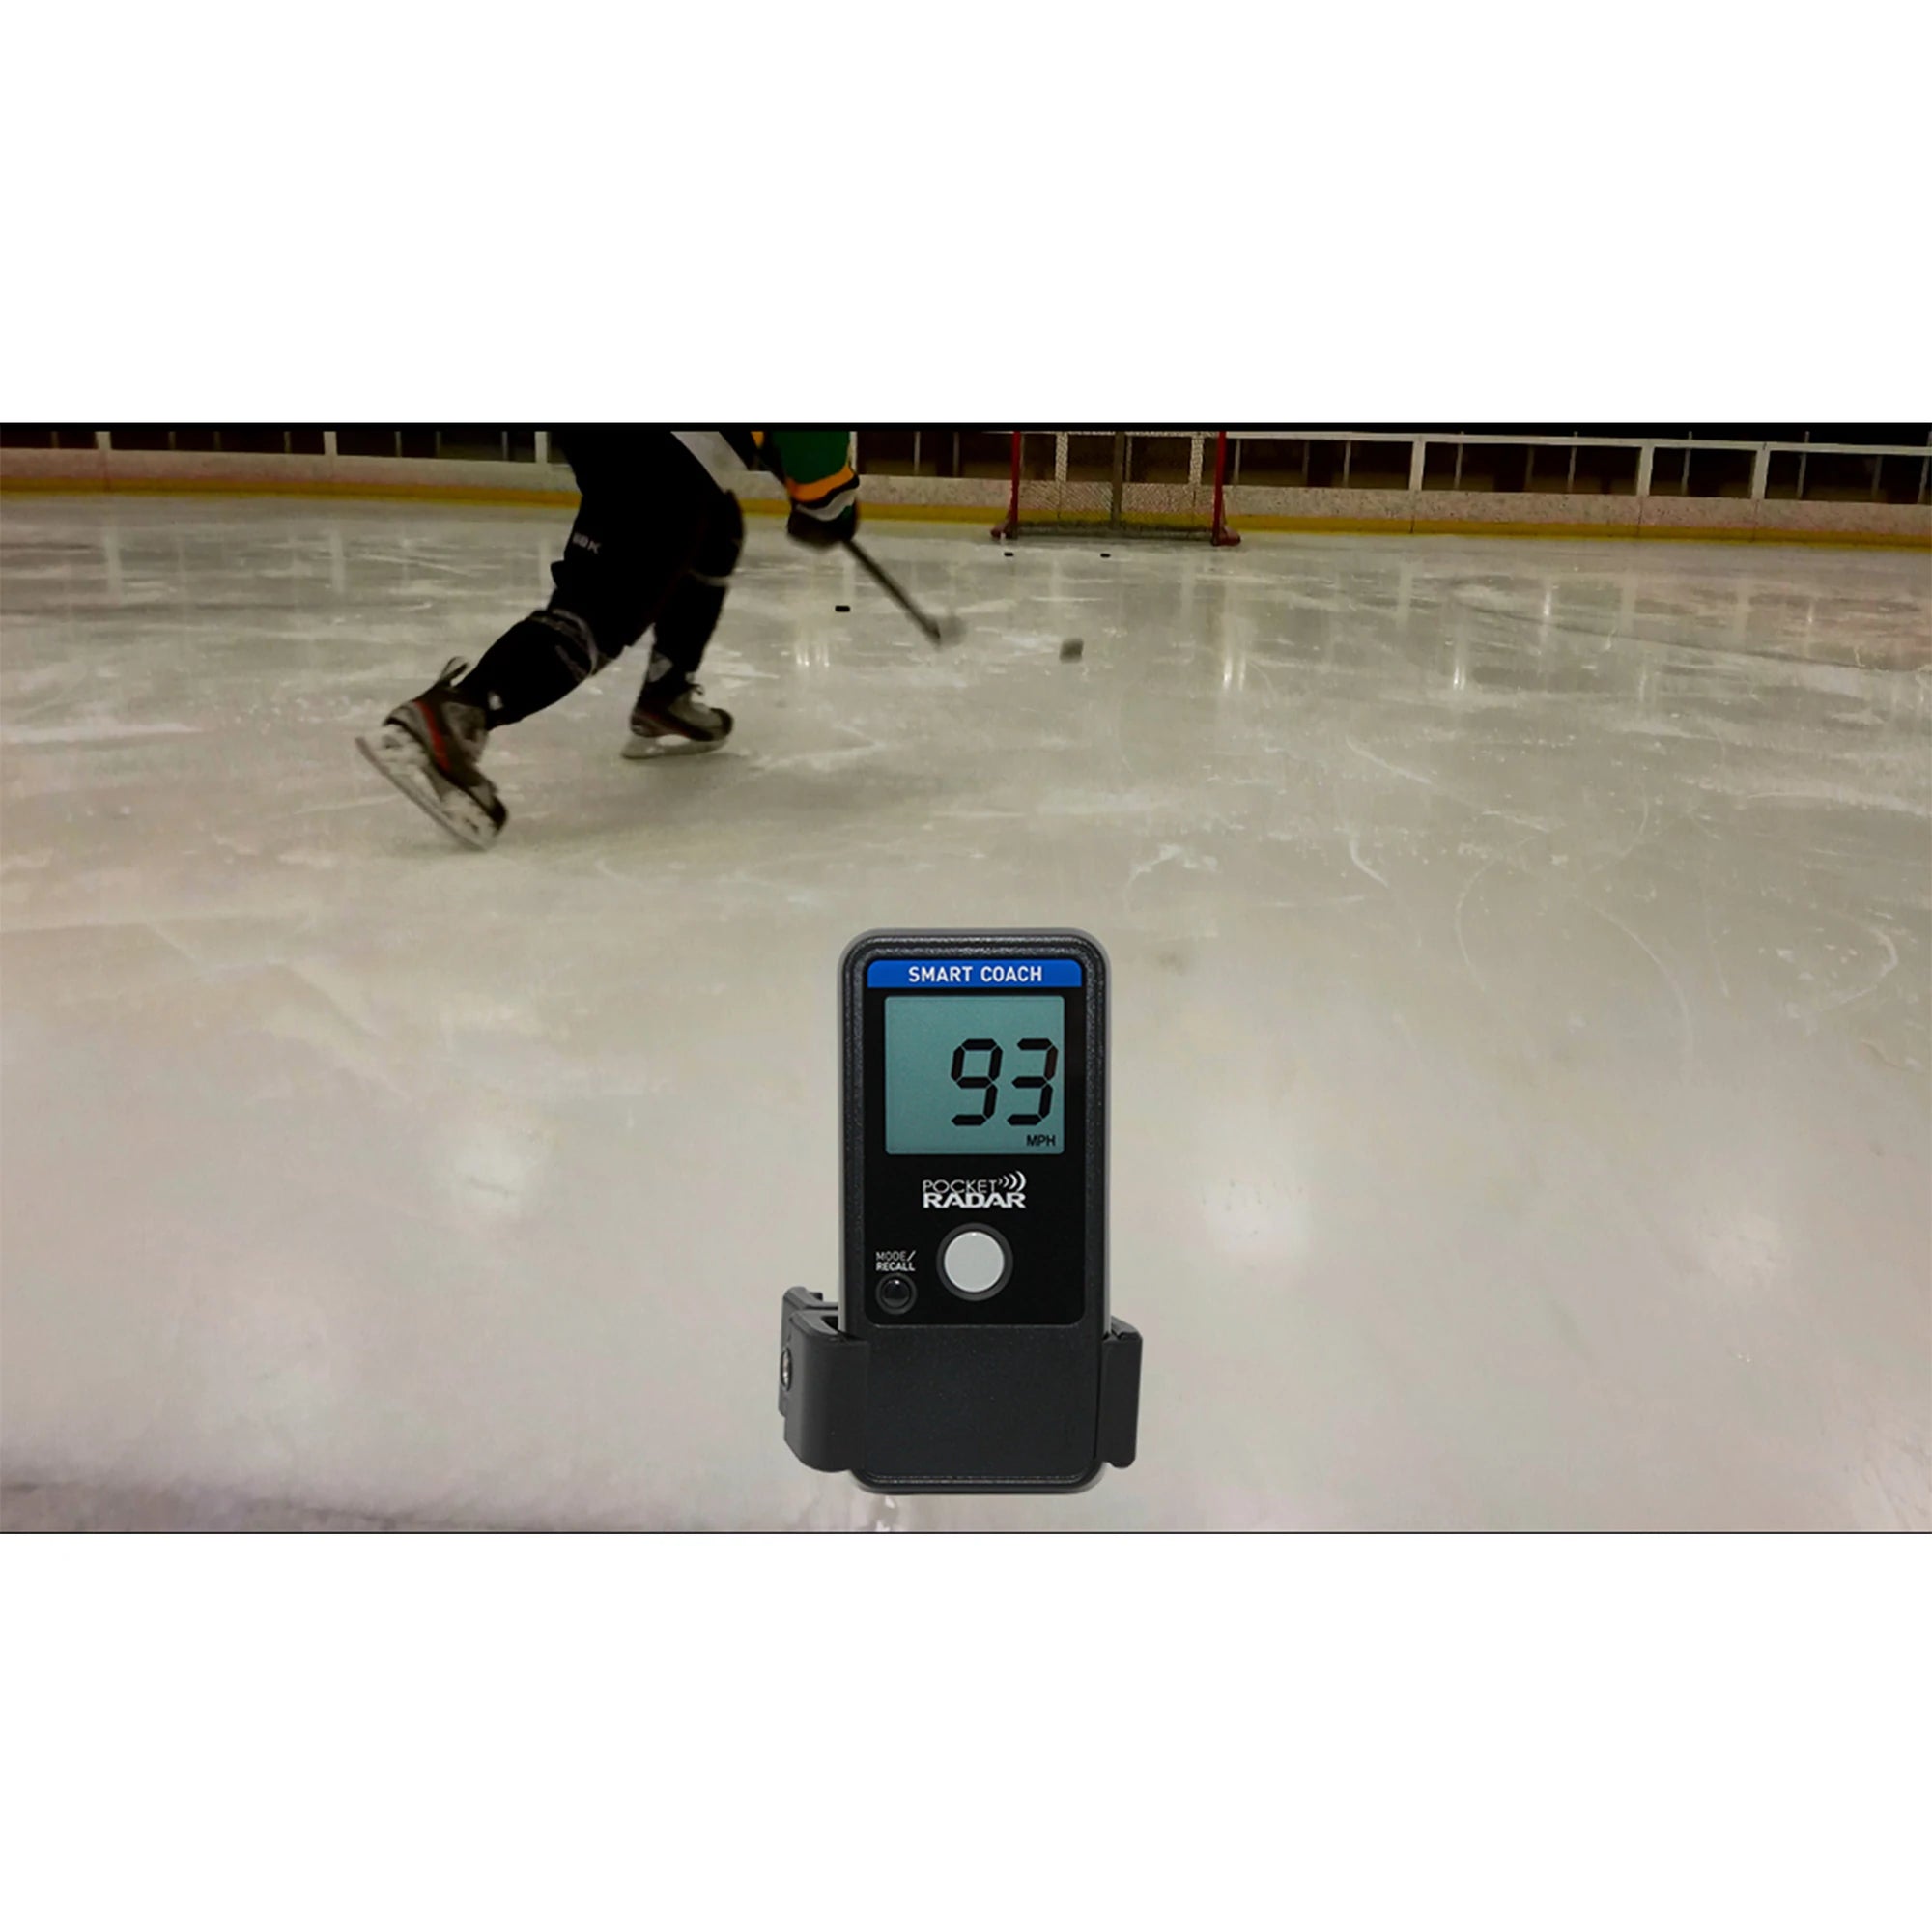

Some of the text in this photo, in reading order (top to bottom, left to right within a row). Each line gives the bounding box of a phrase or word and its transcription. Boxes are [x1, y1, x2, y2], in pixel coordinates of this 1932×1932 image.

[908, 966, 1042, 982] SMART COACH
[951, 1038, 1059, 1126] 93
[1026, 1134, 1056, 1147] MPH
[923, 1179, 998, 1193] POCKET
[923, 1193, 1027, 1208] RADAR
[876, 1262, 915, 1271] RECALL
